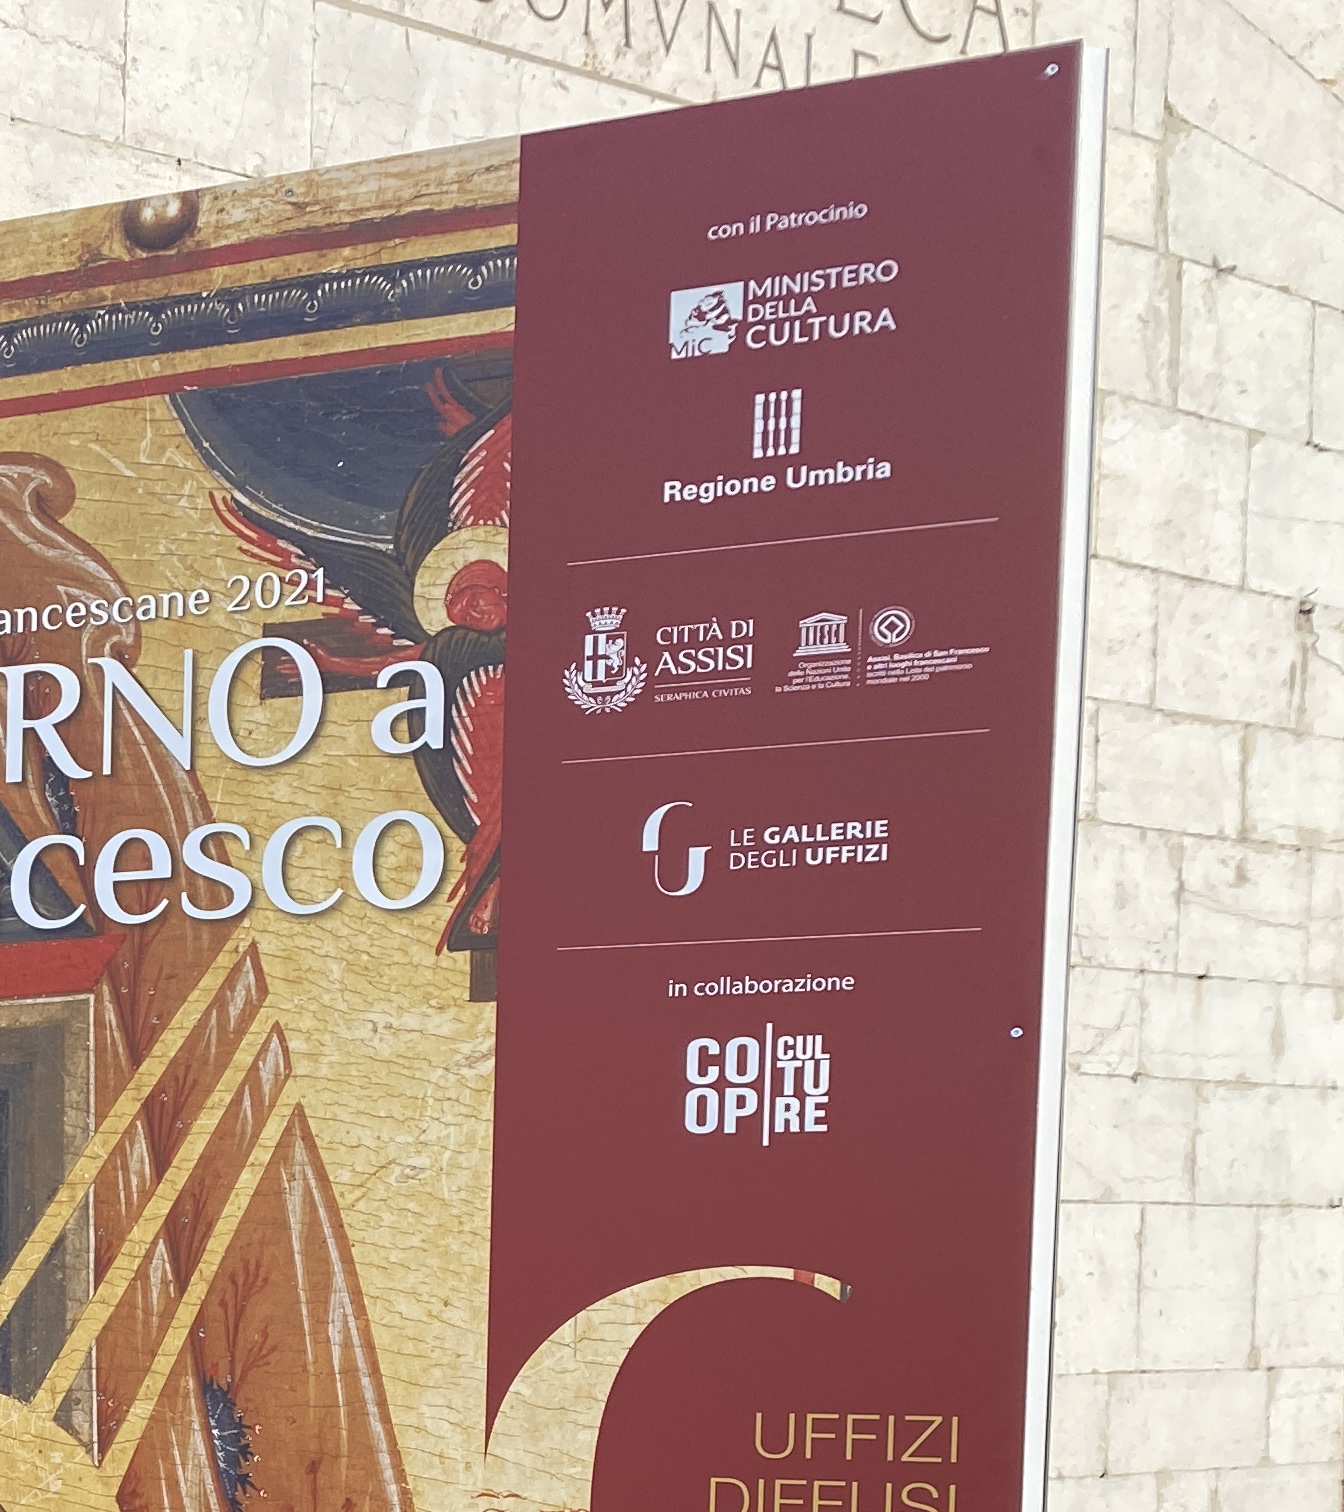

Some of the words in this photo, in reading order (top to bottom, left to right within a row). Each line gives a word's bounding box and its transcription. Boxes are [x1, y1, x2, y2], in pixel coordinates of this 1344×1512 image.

[707, 221, 744, 241] con
[749, 215, 761, 235] il
[765, 201, 869, 232] Patrocinio
[748, 258, 900, 300] MINISTERO
[747, 296, 818, 323] DELLA
[745, 307, 897, 350] CULTURA
[662, 468, 777, 505] Regione
[785, 457, 892, 491] Umbria
[226, 566, 328, 615] 2021
[656, 616, 724, 646] CITTÀ
[730, 618, 755, 640] DI
[654, 644, 754, 677] ASSISI
[370, 660, 446, 756] a
[654, 689, 710, 703] SERAPHICA
[712, 686, 753, 698] CIVITAS
[729, 827, 756, 848] LE
[763, 819, 890, 844] GALLERIE
[729, 849, 798, 870] DEGLI
[805, 843, 889, 865] UFFIZI
[667, 978, 688, 998] in
[693, 973, 855, 998] collaborazione
[753, 1411, 959, 1464] UFFIZI
